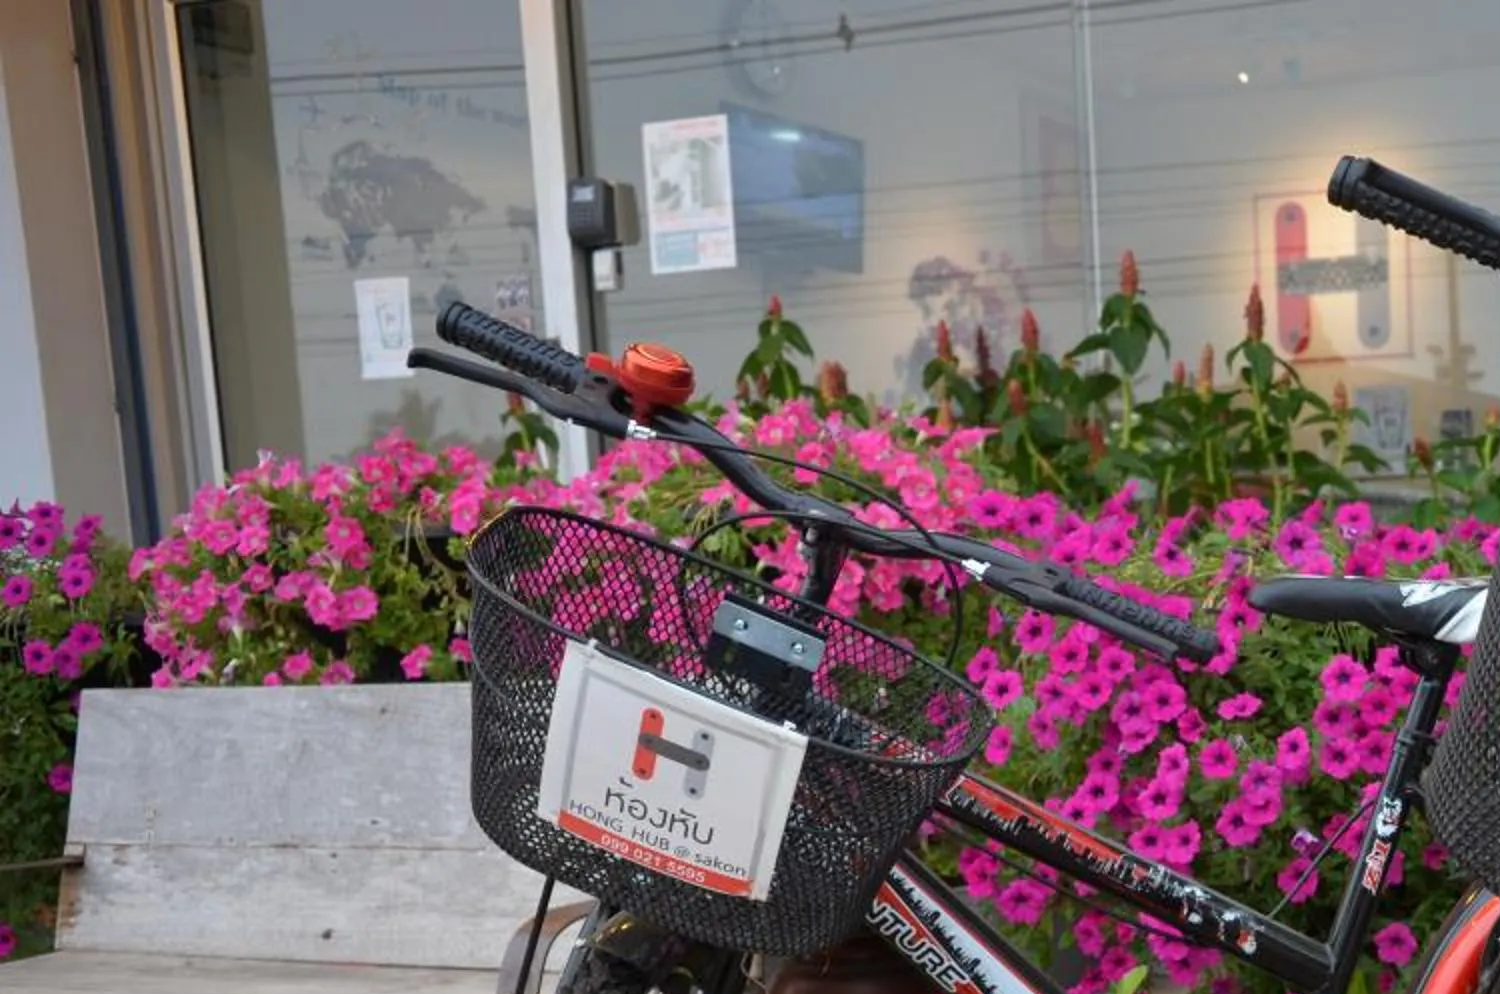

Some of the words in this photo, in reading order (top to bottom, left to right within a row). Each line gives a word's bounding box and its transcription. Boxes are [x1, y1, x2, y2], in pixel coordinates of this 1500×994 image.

[569, 799, 624, 833] HONG
[631, 827, 671, 851] HUB
[673, 845, 691, 857] @
[694, 851, 748, 877] sakon
[604, 776, 715, 846] ห้องหับ
[633, 847, 661, 868] 021
